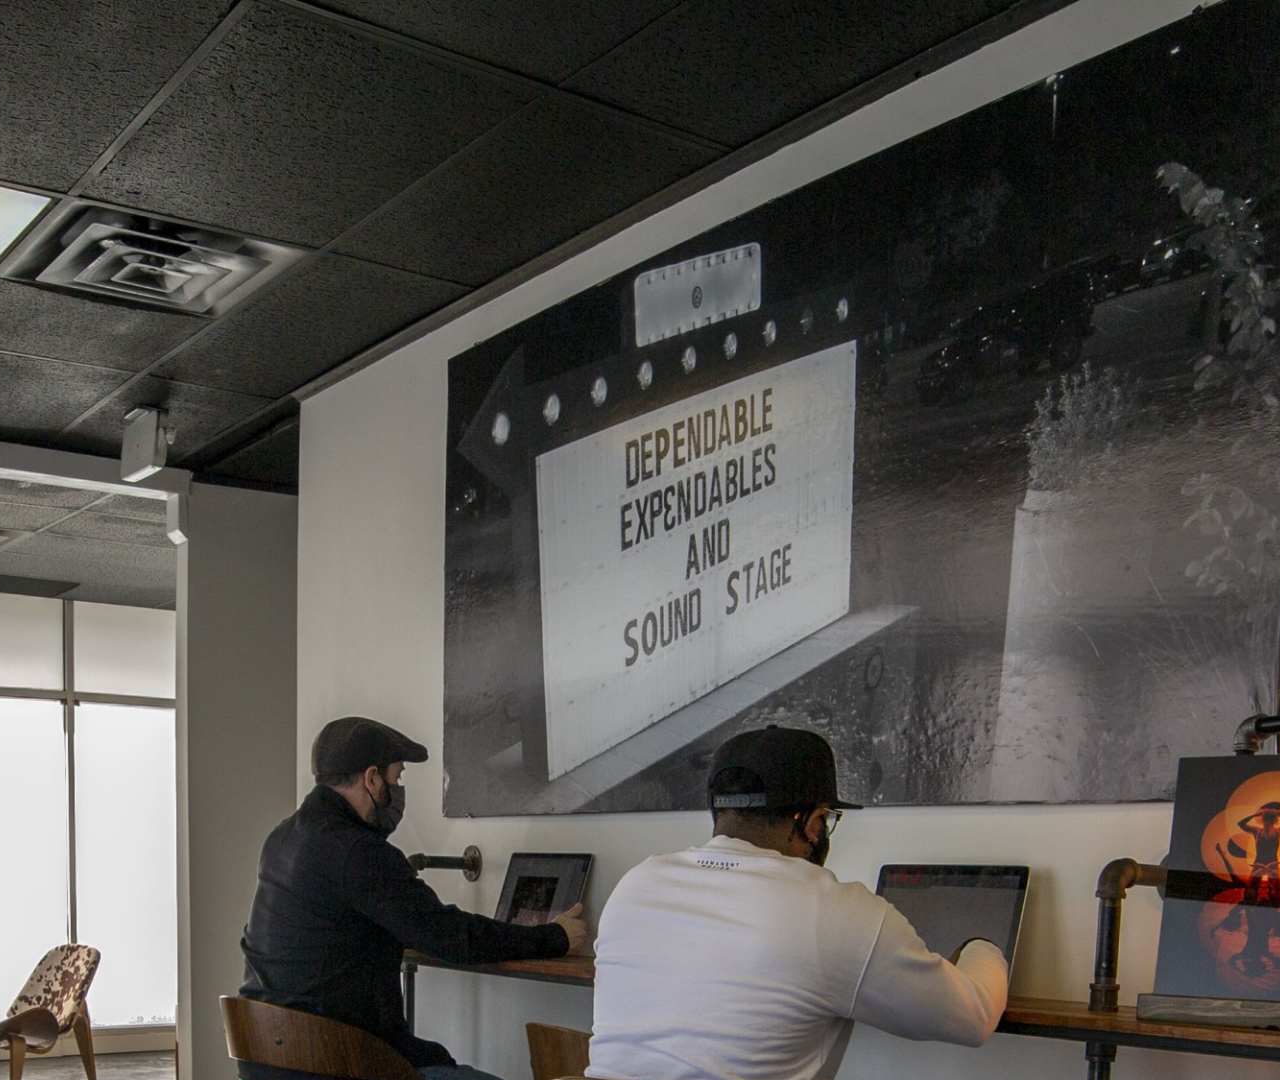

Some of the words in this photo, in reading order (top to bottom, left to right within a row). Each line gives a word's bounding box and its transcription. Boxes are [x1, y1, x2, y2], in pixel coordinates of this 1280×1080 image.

[625, 387, 774, 489] DEPENDABLE
[620, 443, 777, 551] EXPENDABLES
[685, 517, 731, 580] AND
[623, 587, 702, 667] SOUND
[725, 542, 793, 616] STAGE
